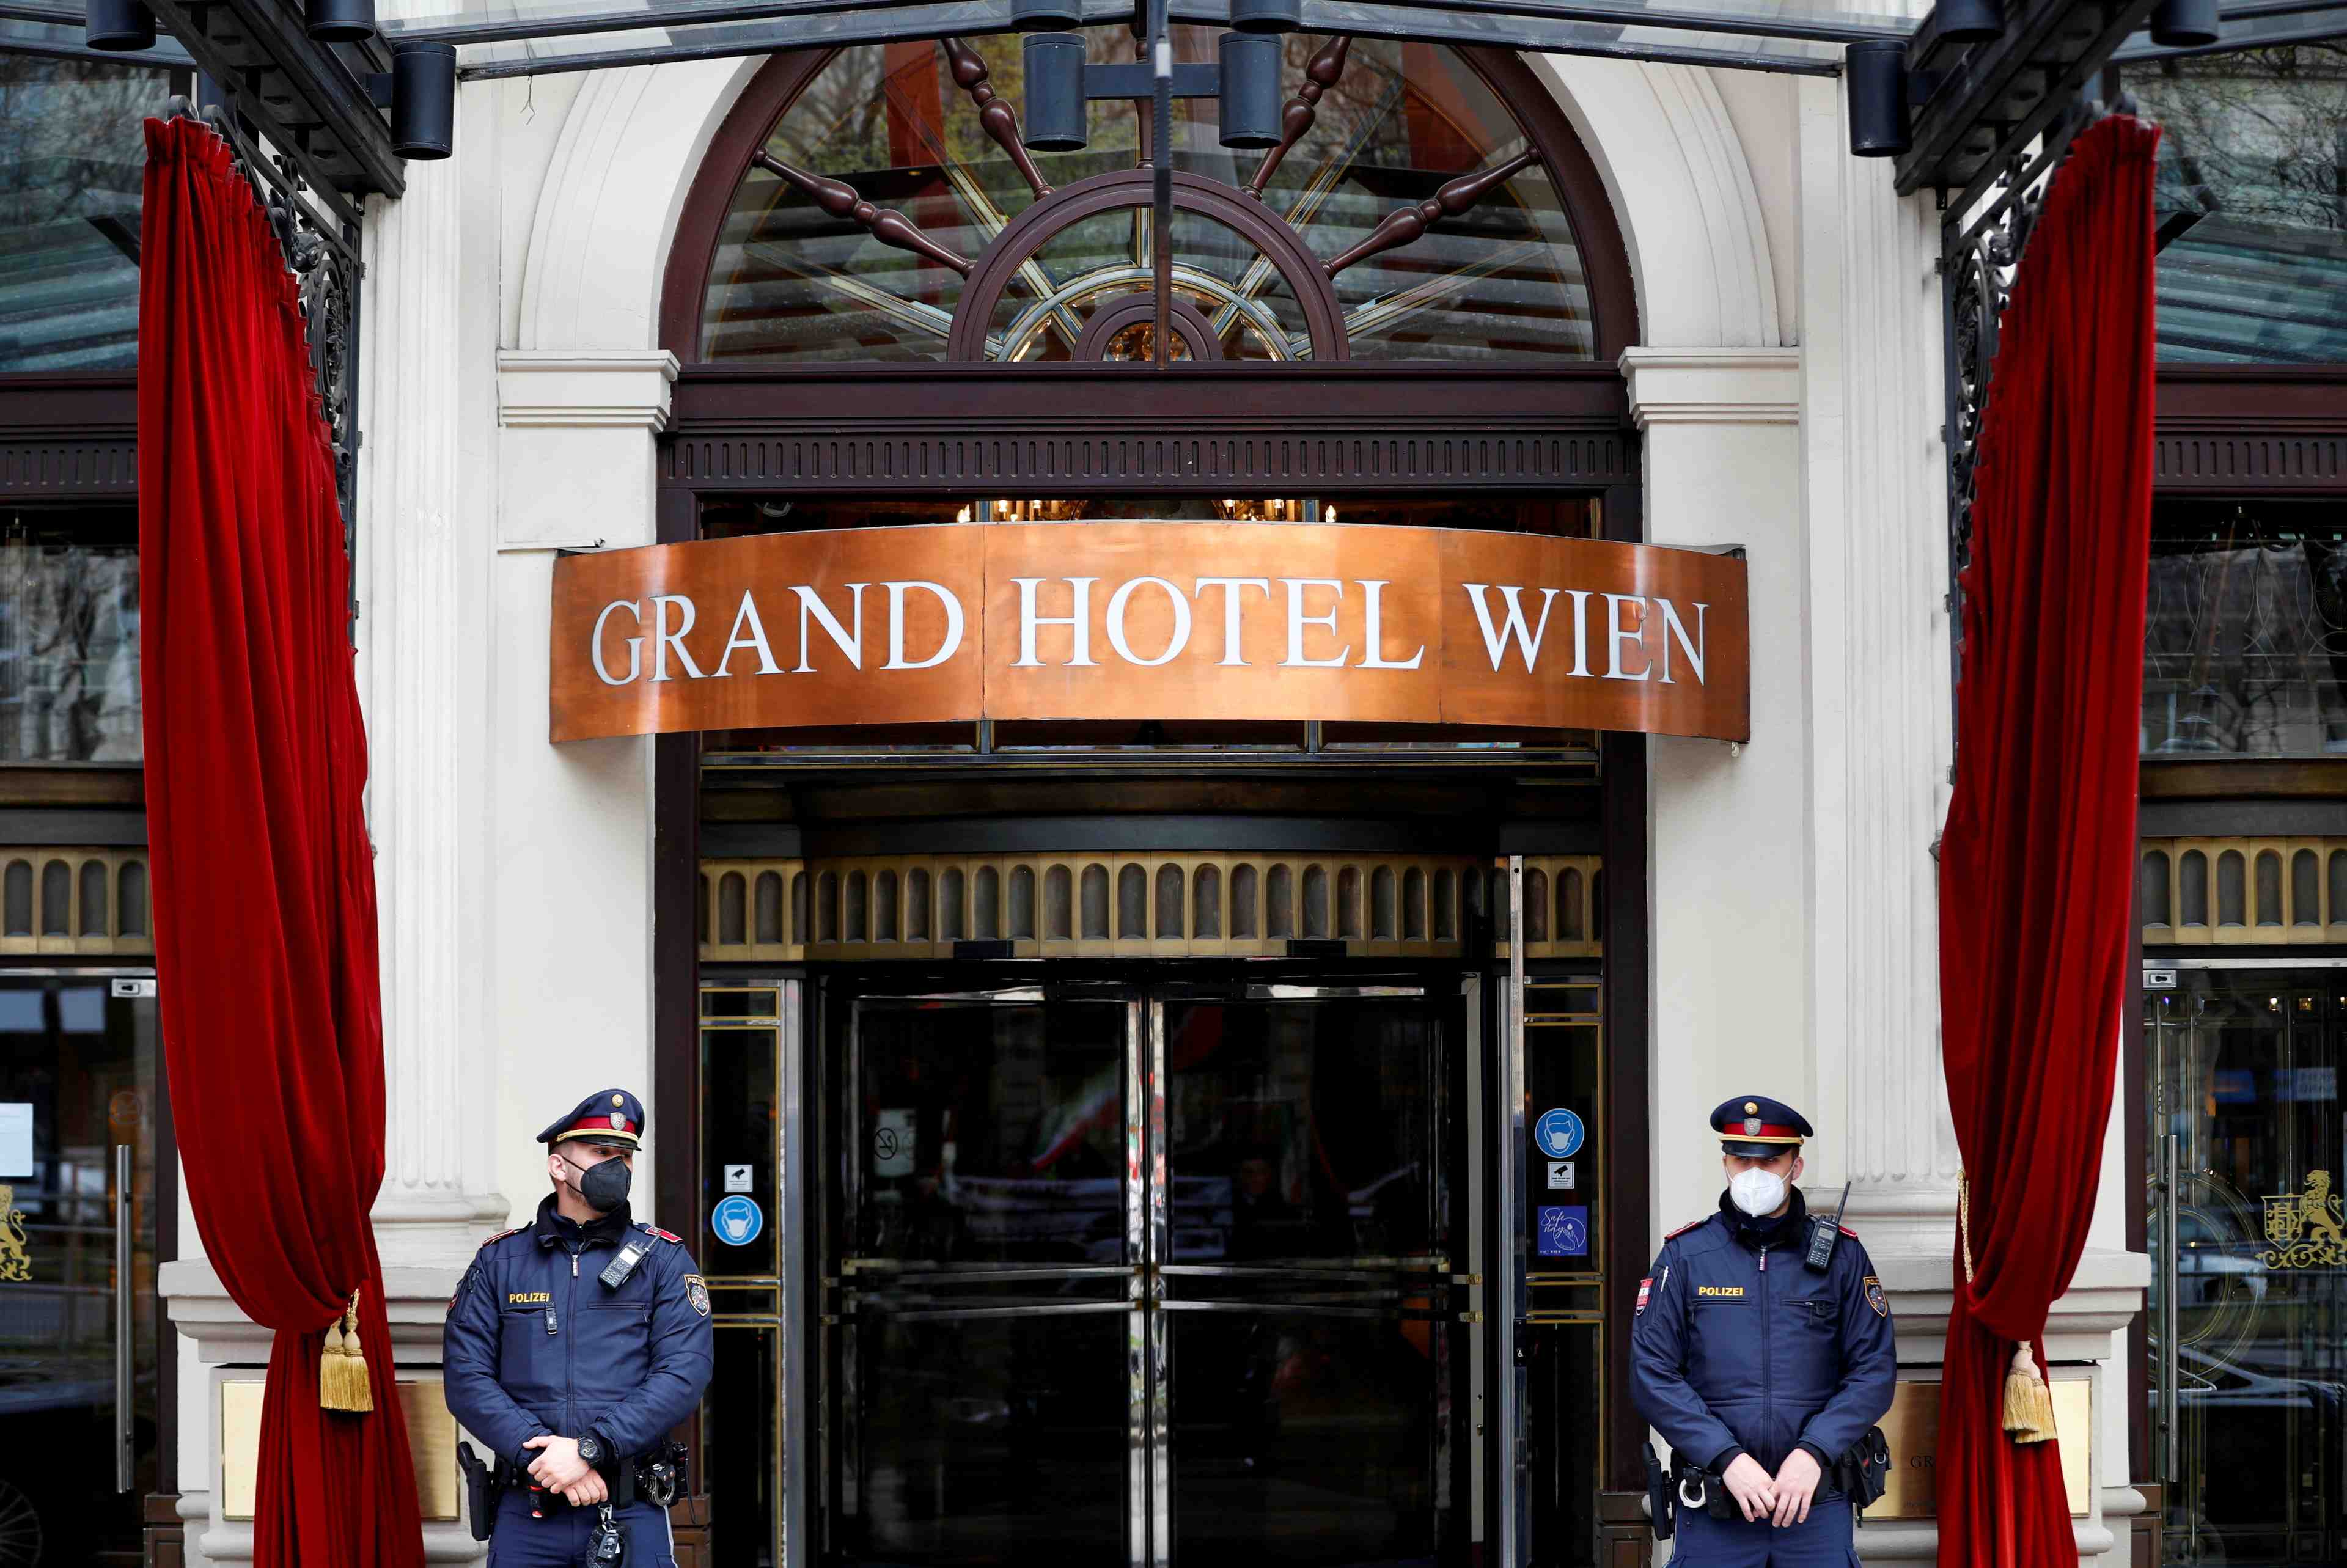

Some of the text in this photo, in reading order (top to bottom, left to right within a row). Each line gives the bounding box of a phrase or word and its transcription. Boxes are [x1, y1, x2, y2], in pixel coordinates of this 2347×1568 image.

[592, 576, 1710, 687] GRAND HOTEL WIEN
[1699, 1286, 1744, 1296] POLIZEI
[509, 1292, 550, 1303] POLIZEI
